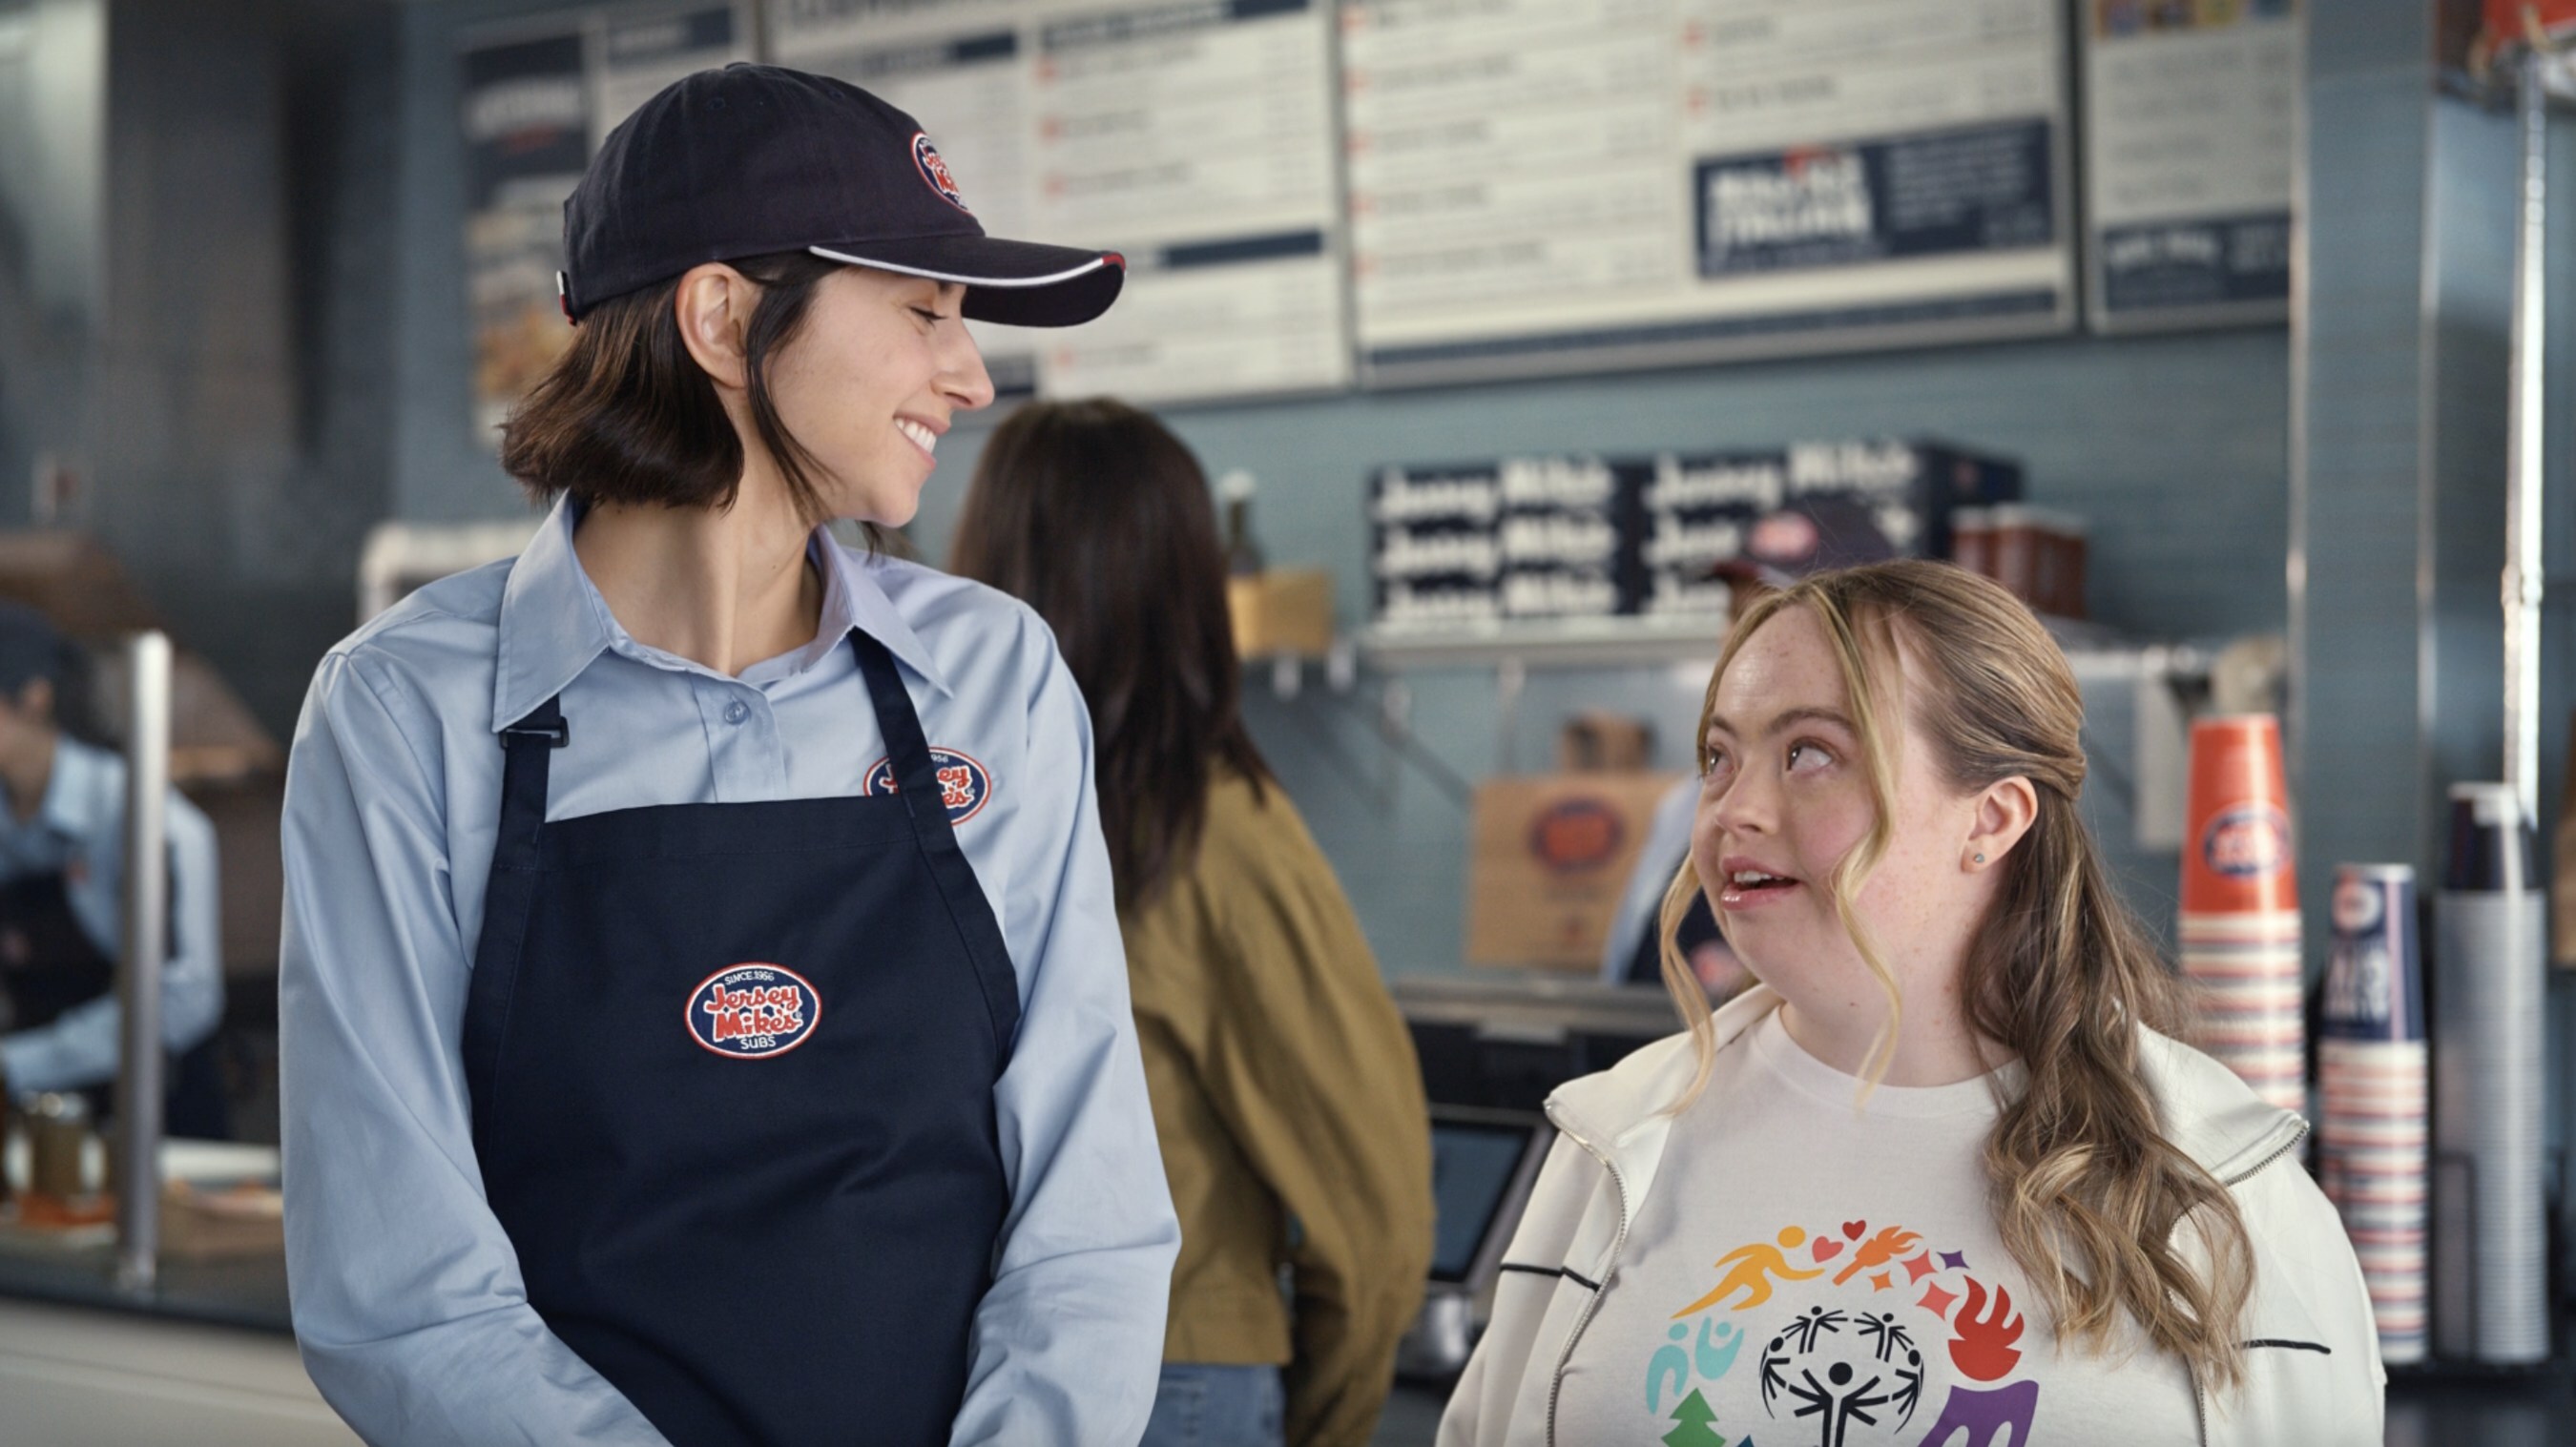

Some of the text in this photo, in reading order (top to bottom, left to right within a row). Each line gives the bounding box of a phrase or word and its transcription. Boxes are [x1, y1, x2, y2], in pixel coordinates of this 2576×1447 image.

[724, 972, 752, 985] SINCE
[704, 983, 803, 1012] Jersey
[713, 1006, 803, 1042] Mike's
[739, 1036, 777, 1050] SUBS
